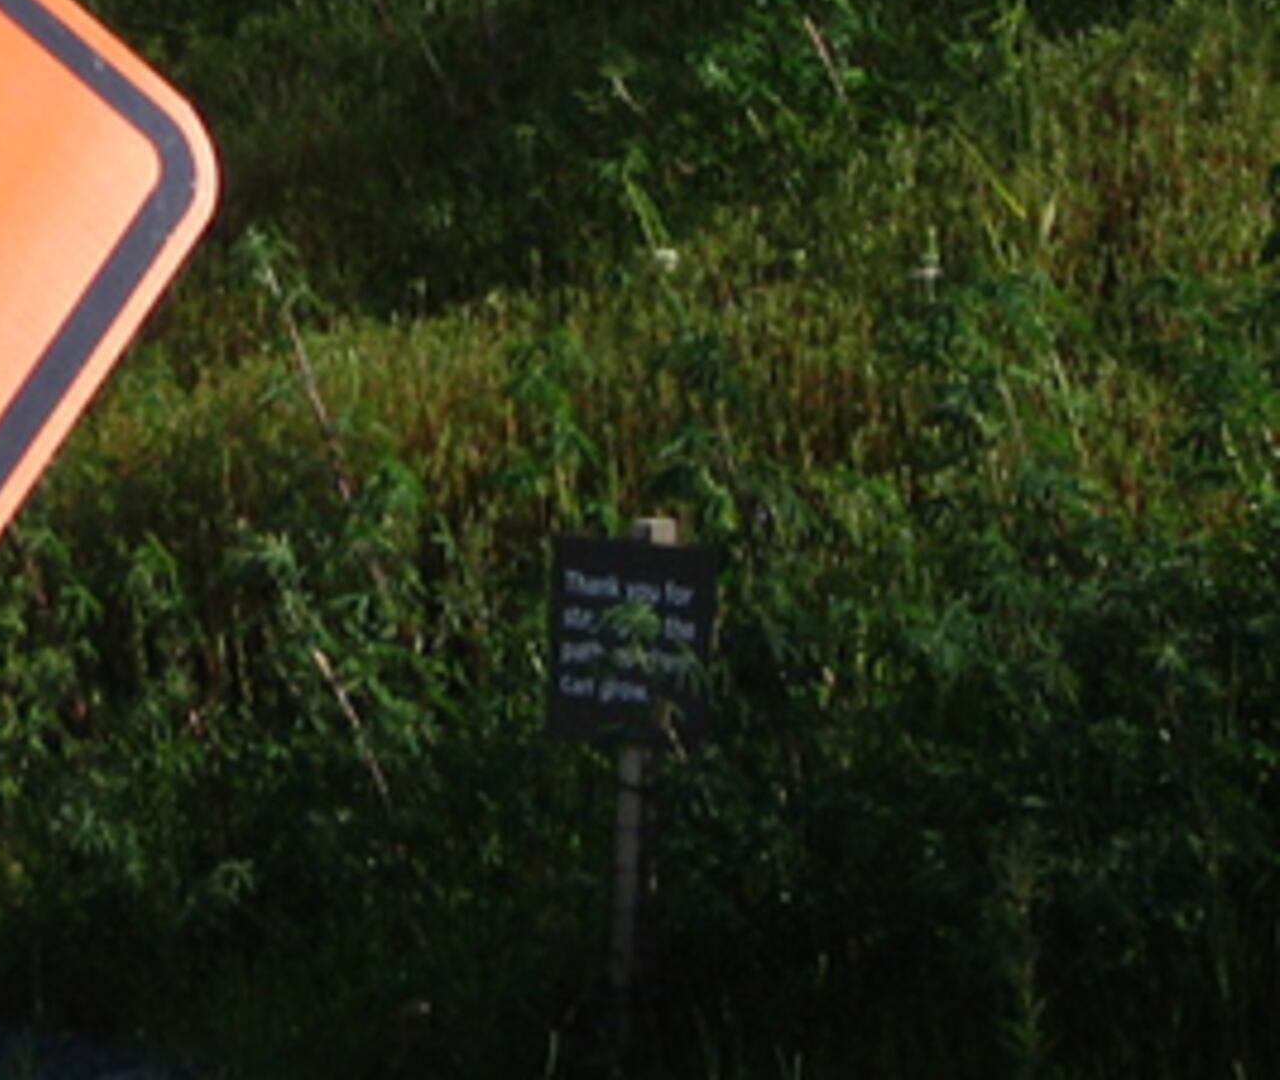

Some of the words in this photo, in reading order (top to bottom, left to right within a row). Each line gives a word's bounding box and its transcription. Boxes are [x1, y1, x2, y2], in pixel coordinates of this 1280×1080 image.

[564, 569, 619, 597] Thank
[625, 583, 661, 606] you
[665, 581, 695, 606] for
